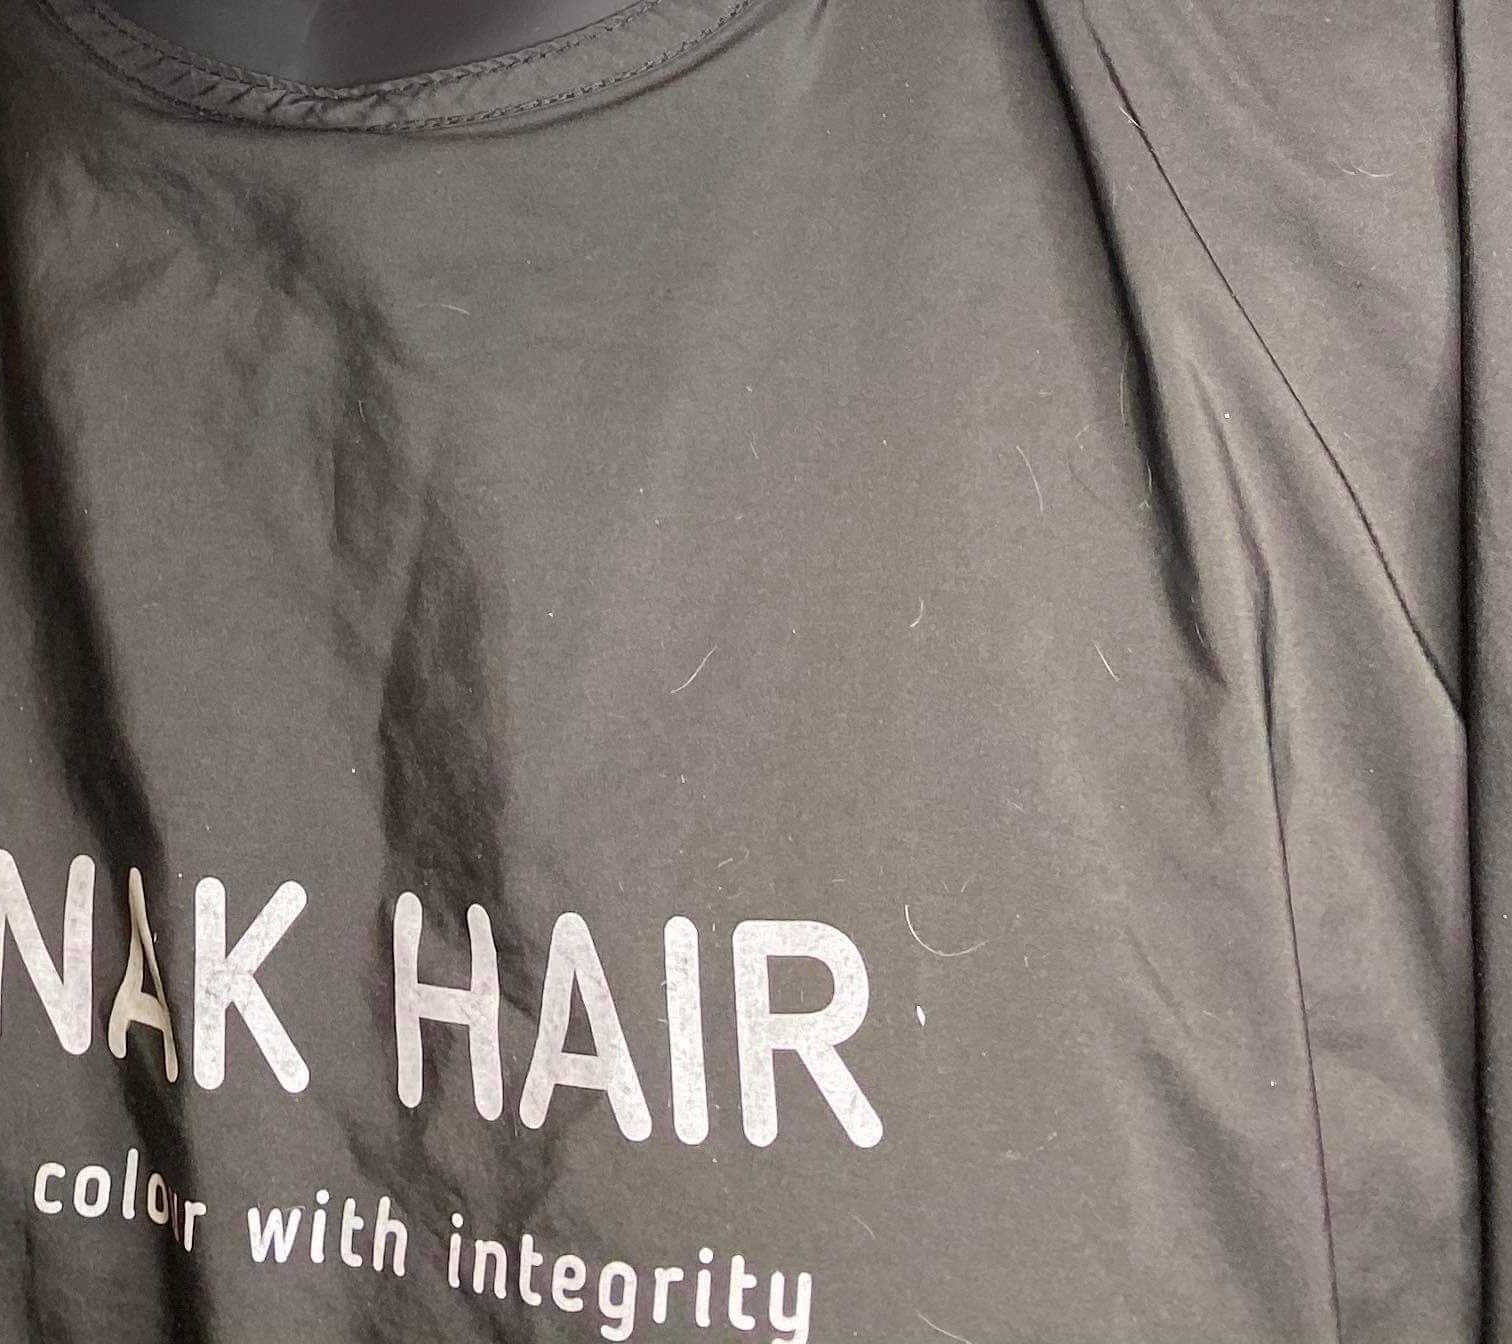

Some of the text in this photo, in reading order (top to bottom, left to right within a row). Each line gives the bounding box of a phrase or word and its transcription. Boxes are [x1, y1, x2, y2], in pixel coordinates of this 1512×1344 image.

[393, 891, 885, 1148] HAIR
[247, 1188, 409, 1278] with
[447, 1211, 814, 1344] integrity
